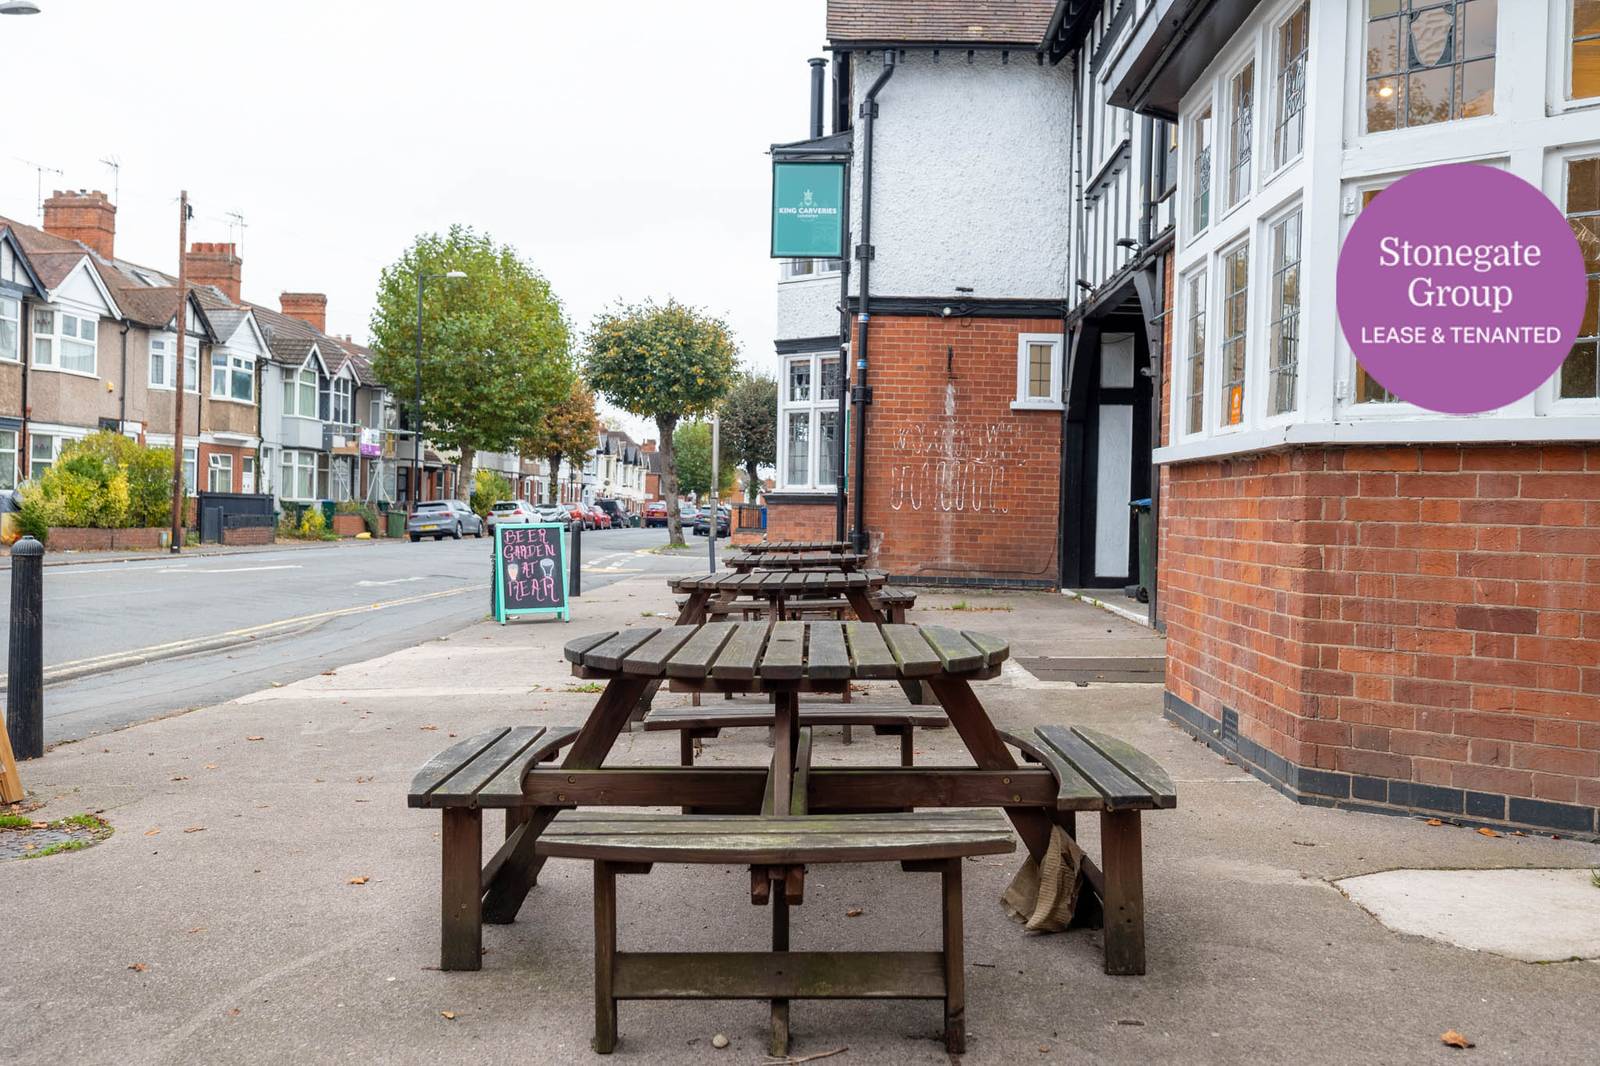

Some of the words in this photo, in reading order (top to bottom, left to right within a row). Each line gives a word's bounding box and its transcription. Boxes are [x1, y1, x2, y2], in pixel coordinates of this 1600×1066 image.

[504, 529, 548, 544] BEER
[503, 544, 555, 560] GARDEN
[522, 560, 538, 578] AT
[508, 576, 559, 602] REAR
